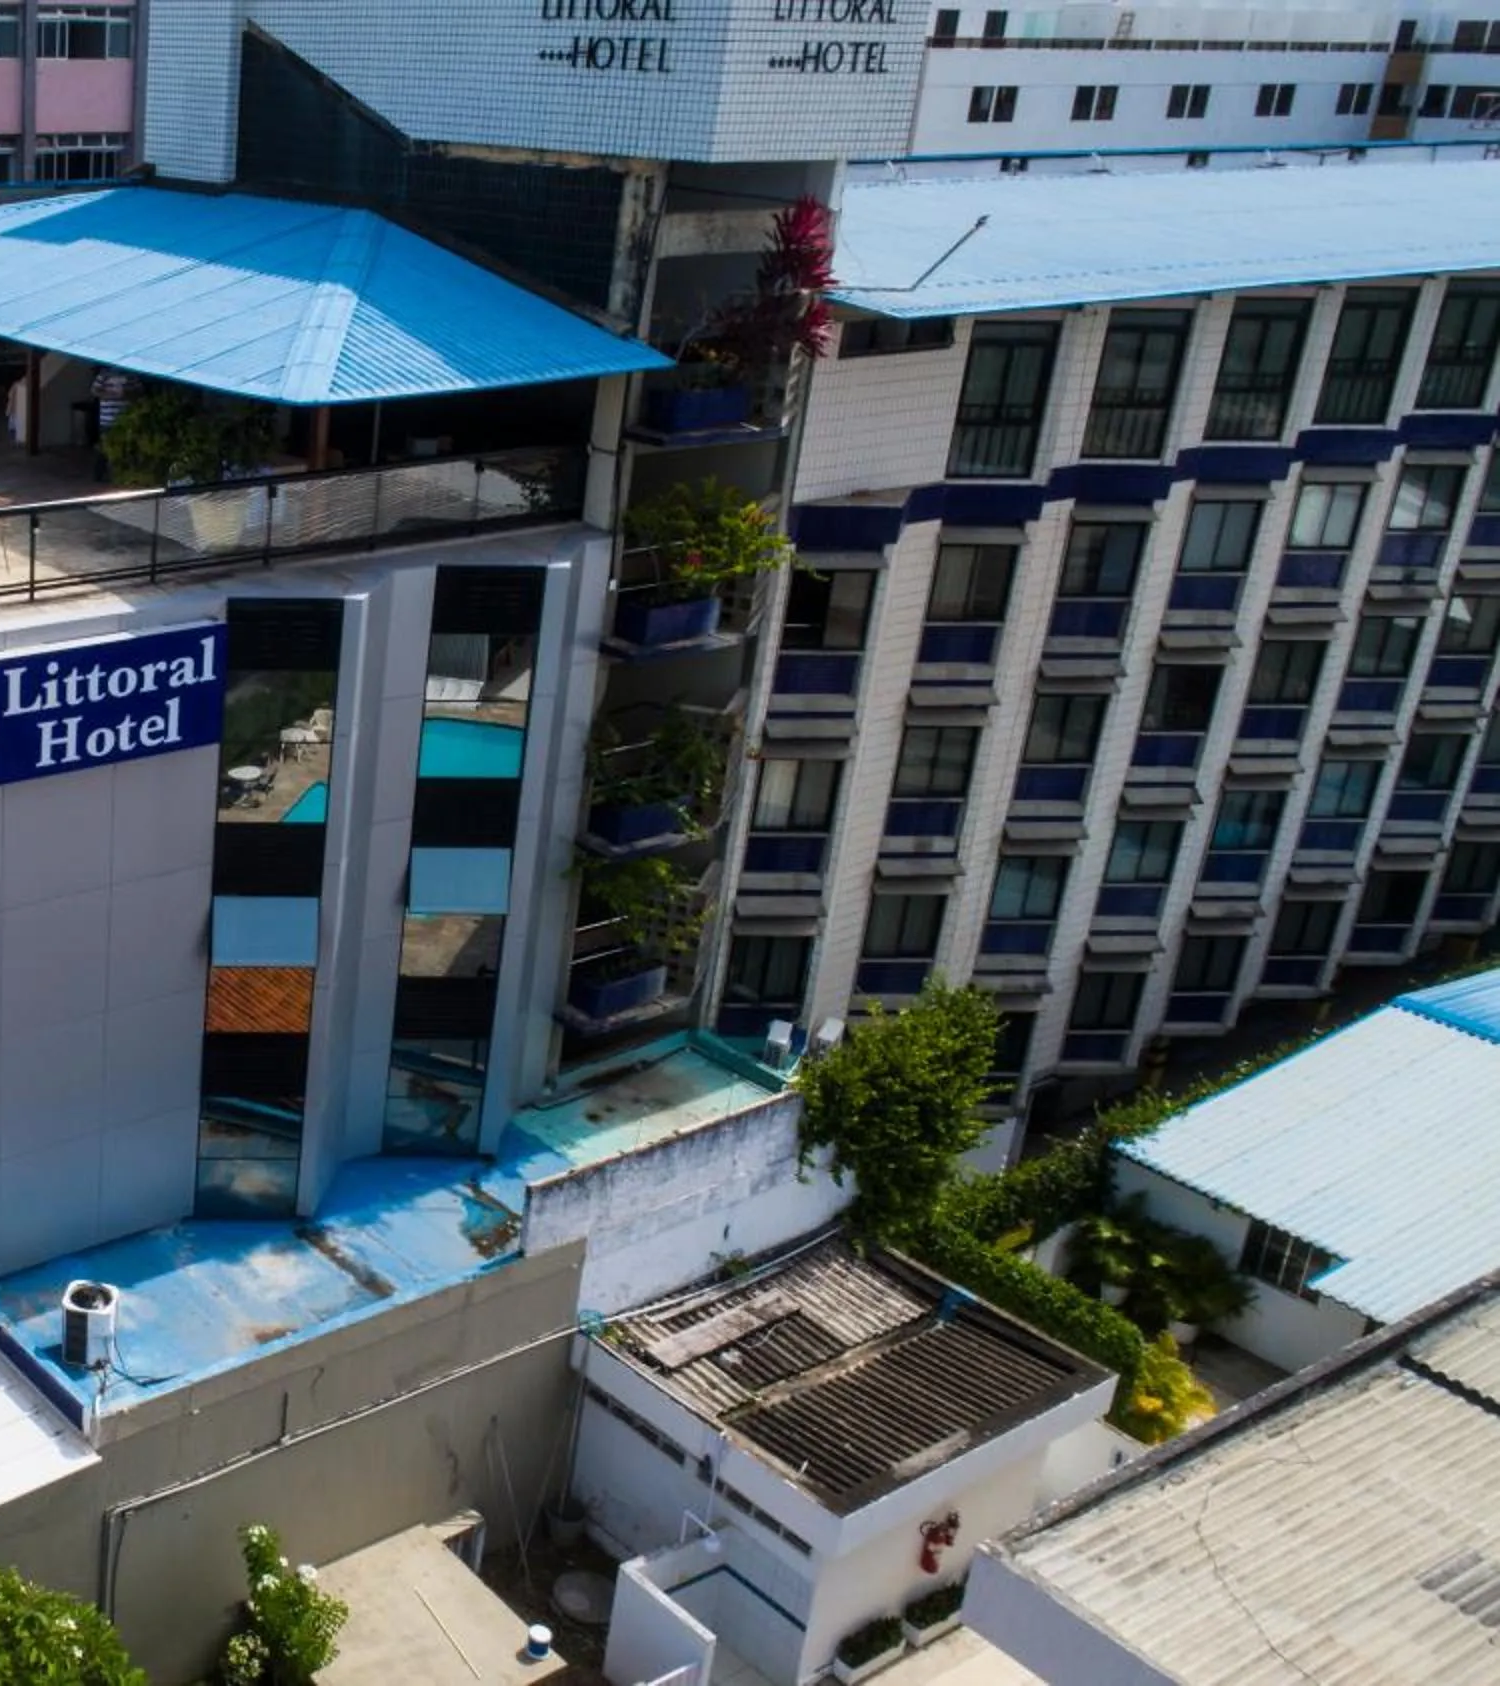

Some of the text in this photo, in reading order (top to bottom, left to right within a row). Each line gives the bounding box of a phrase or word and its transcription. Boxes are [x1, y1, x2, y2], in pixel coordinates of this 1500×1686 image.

[571, 36, 672, 73] HOTEL
[801, 41, 889, 73] HOTEL
[3, 635, 216, 717] Littoral
[36, 697, 183, 768] Hotel
